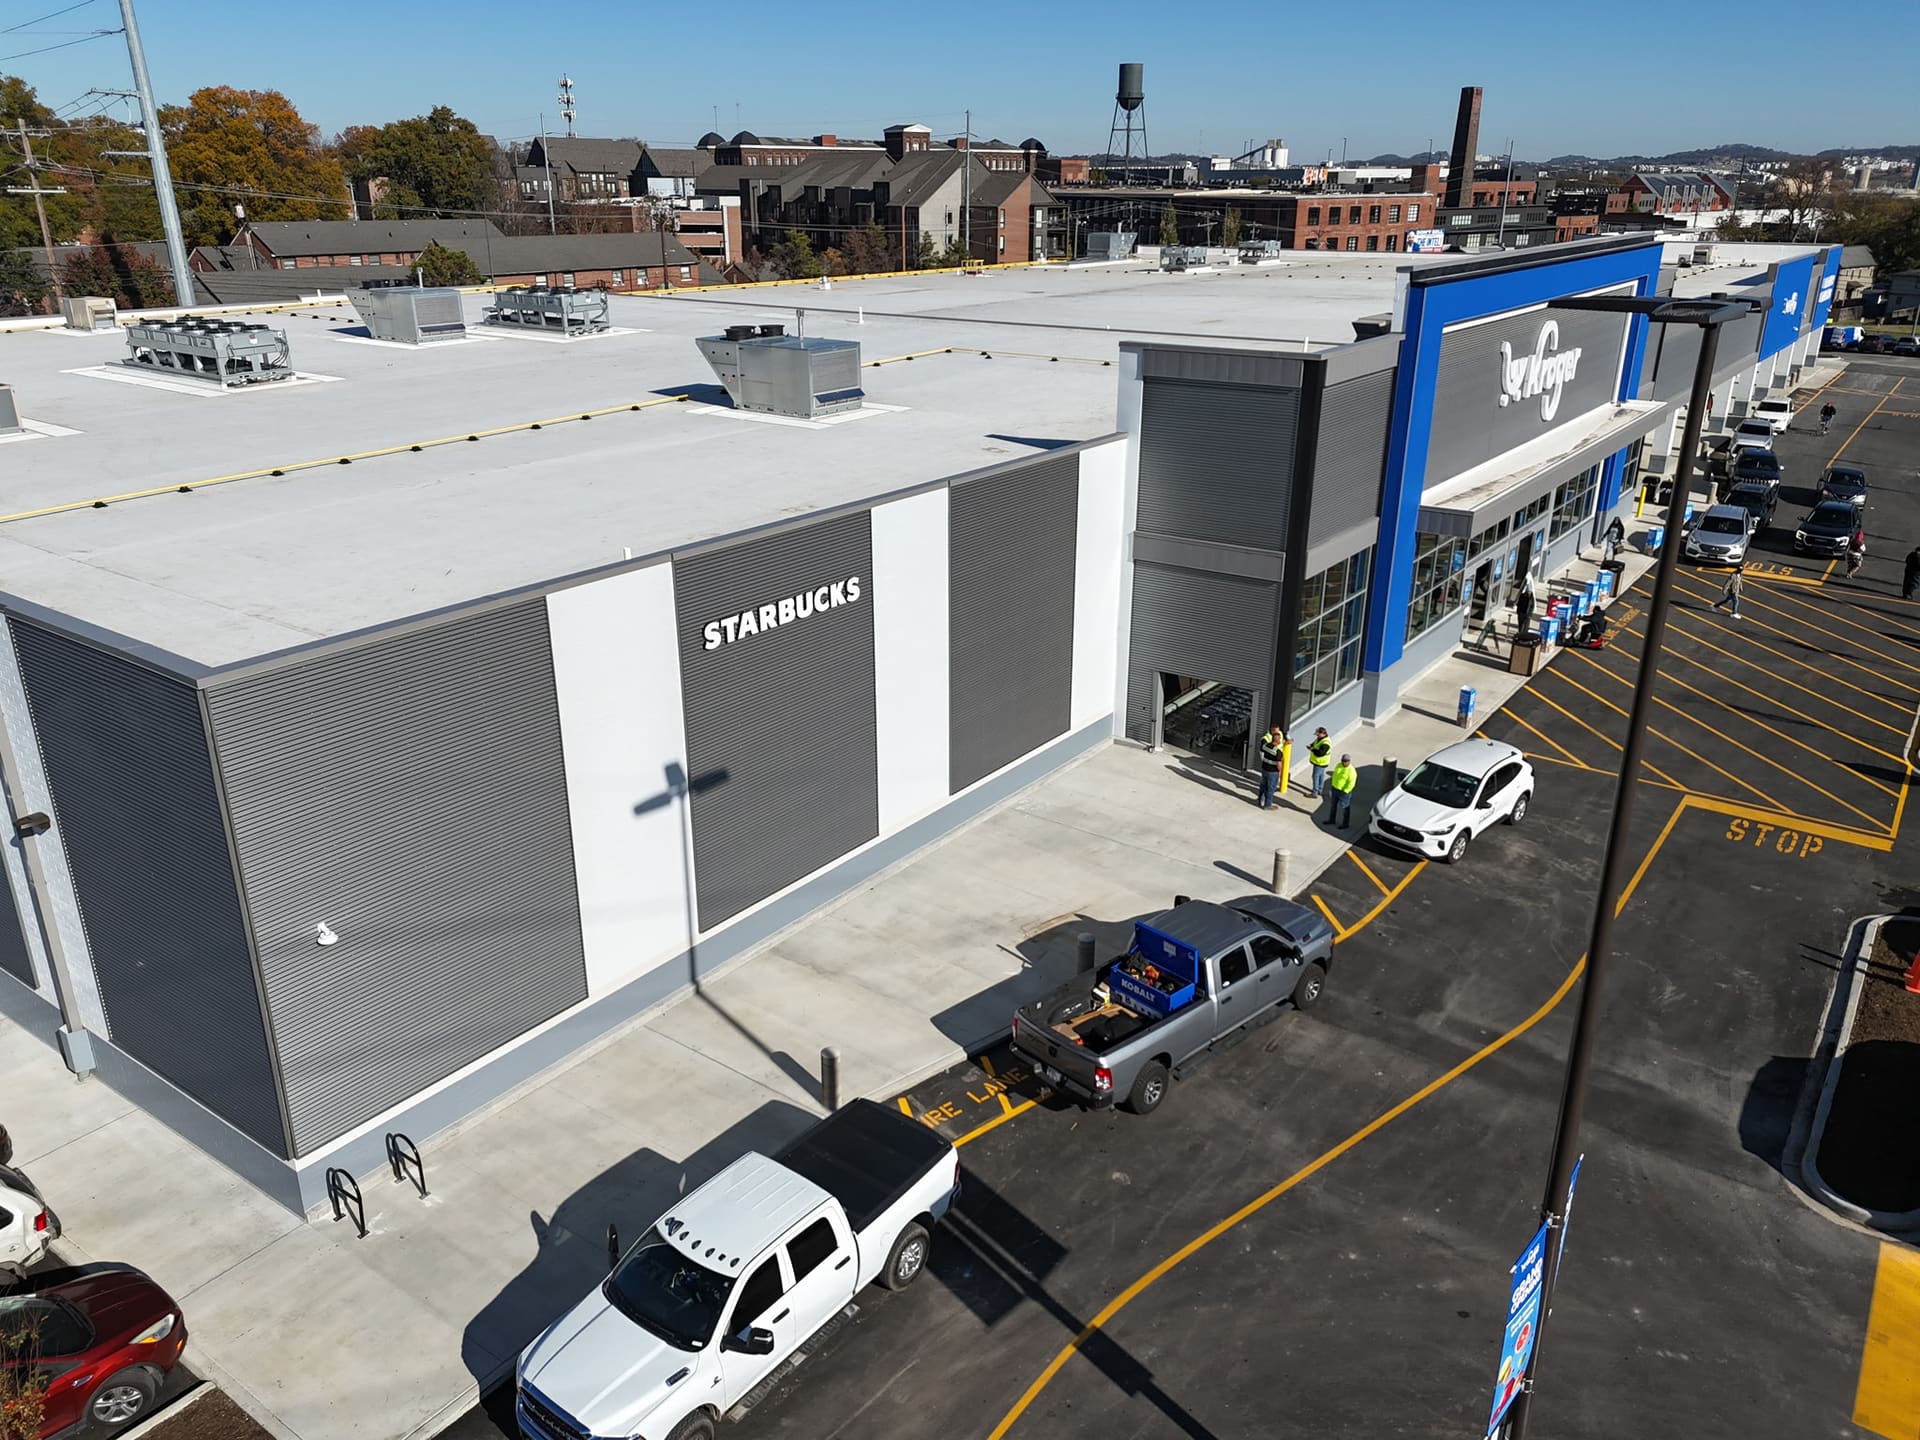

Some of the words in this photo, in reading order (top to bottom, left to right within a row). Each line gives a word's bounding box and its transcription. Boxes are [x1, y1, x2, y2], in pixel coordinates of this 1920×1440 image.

[1522, 319, 1582, 421] Kroger
[703, 576, 861, 650] STARBUCKS
[1725, 818, 1824, 858] STOP
[1121, 978, 1155, 1002] KOBALT
[918, 1101, 963, 1128] IRE
[966, 1067, 1029, 1104] LANE
